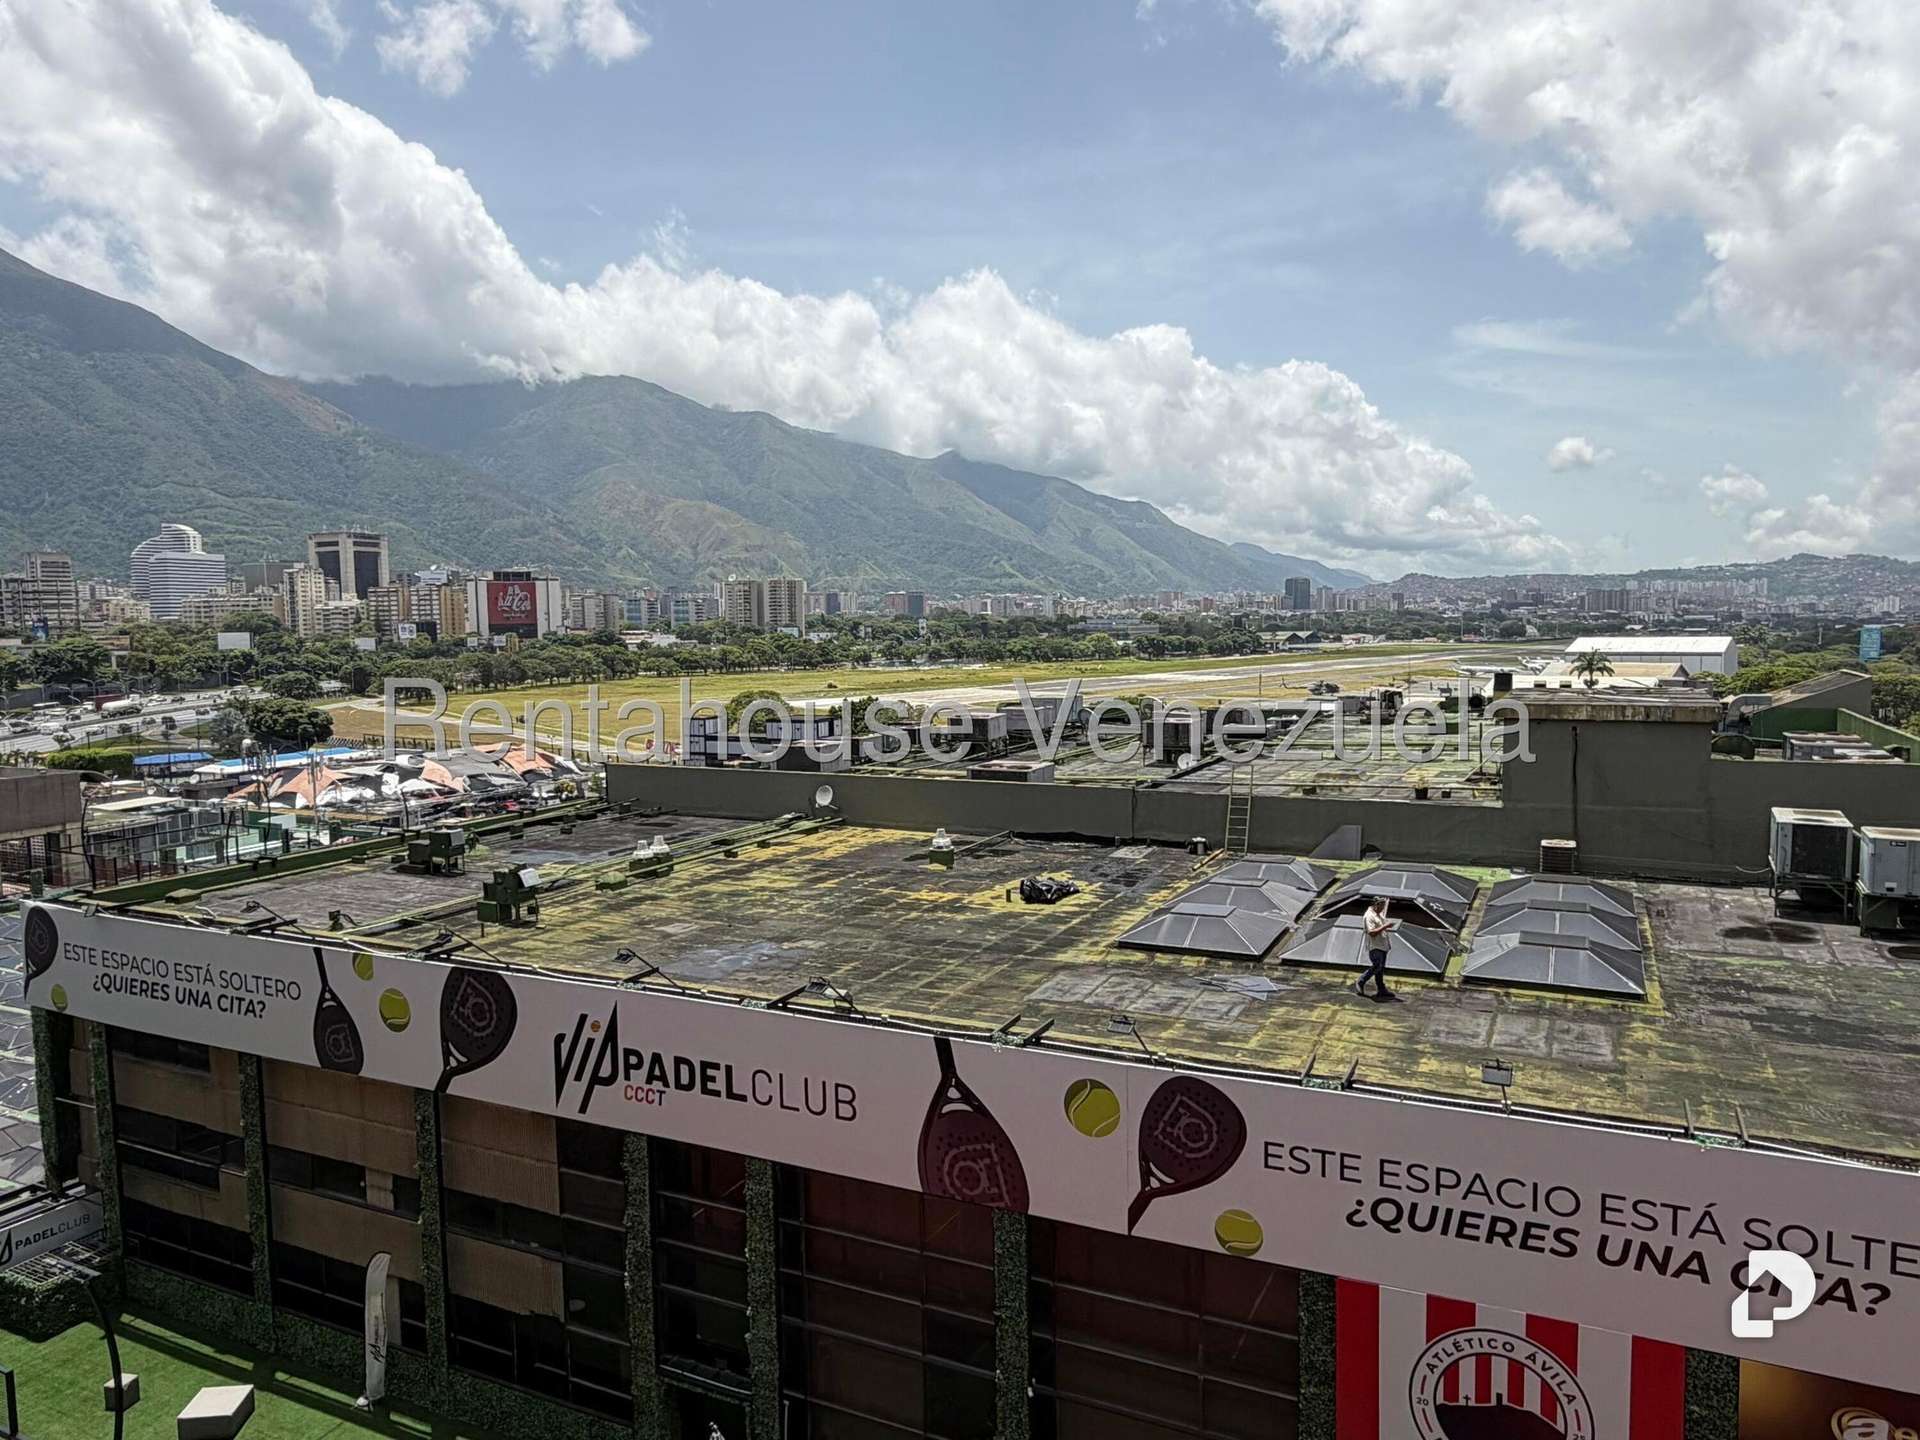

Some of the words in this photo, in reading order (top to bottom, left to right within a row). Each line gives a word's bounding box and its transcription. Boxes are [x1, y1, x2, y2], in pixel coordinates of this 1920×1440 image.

[63, 942, 98, 966] ESTE
[102, 950, 169, 979] ESPACIO
[173, 962, 216, 987] ESTÁ
[219, 969, 302, 1001] SOLTERO
[92, 972, 170, 1003] ¿QUIERES
[175, 986, 213, 1011] UNA
[217, 994, 267, 1019] CITA?
[623, 1084, 667, 1107] CCCT
[1263, 1140, 1363, 1185] ESTE
[1378, 1158, 1582, 1218] ESPACIO
[1600, 1192, 1727, 1246] ESTÁ
[1345, 1197, 1581, 1259] ¿QUIERES
[1596, 1233, 1711, 1285] UNA
[1730, 1259, 1892, 1317] CIA?
[1425, 1337, 1516, 1375] ATLÉTICO
[1524, 1351, 1578, 1406] ÁVILA
